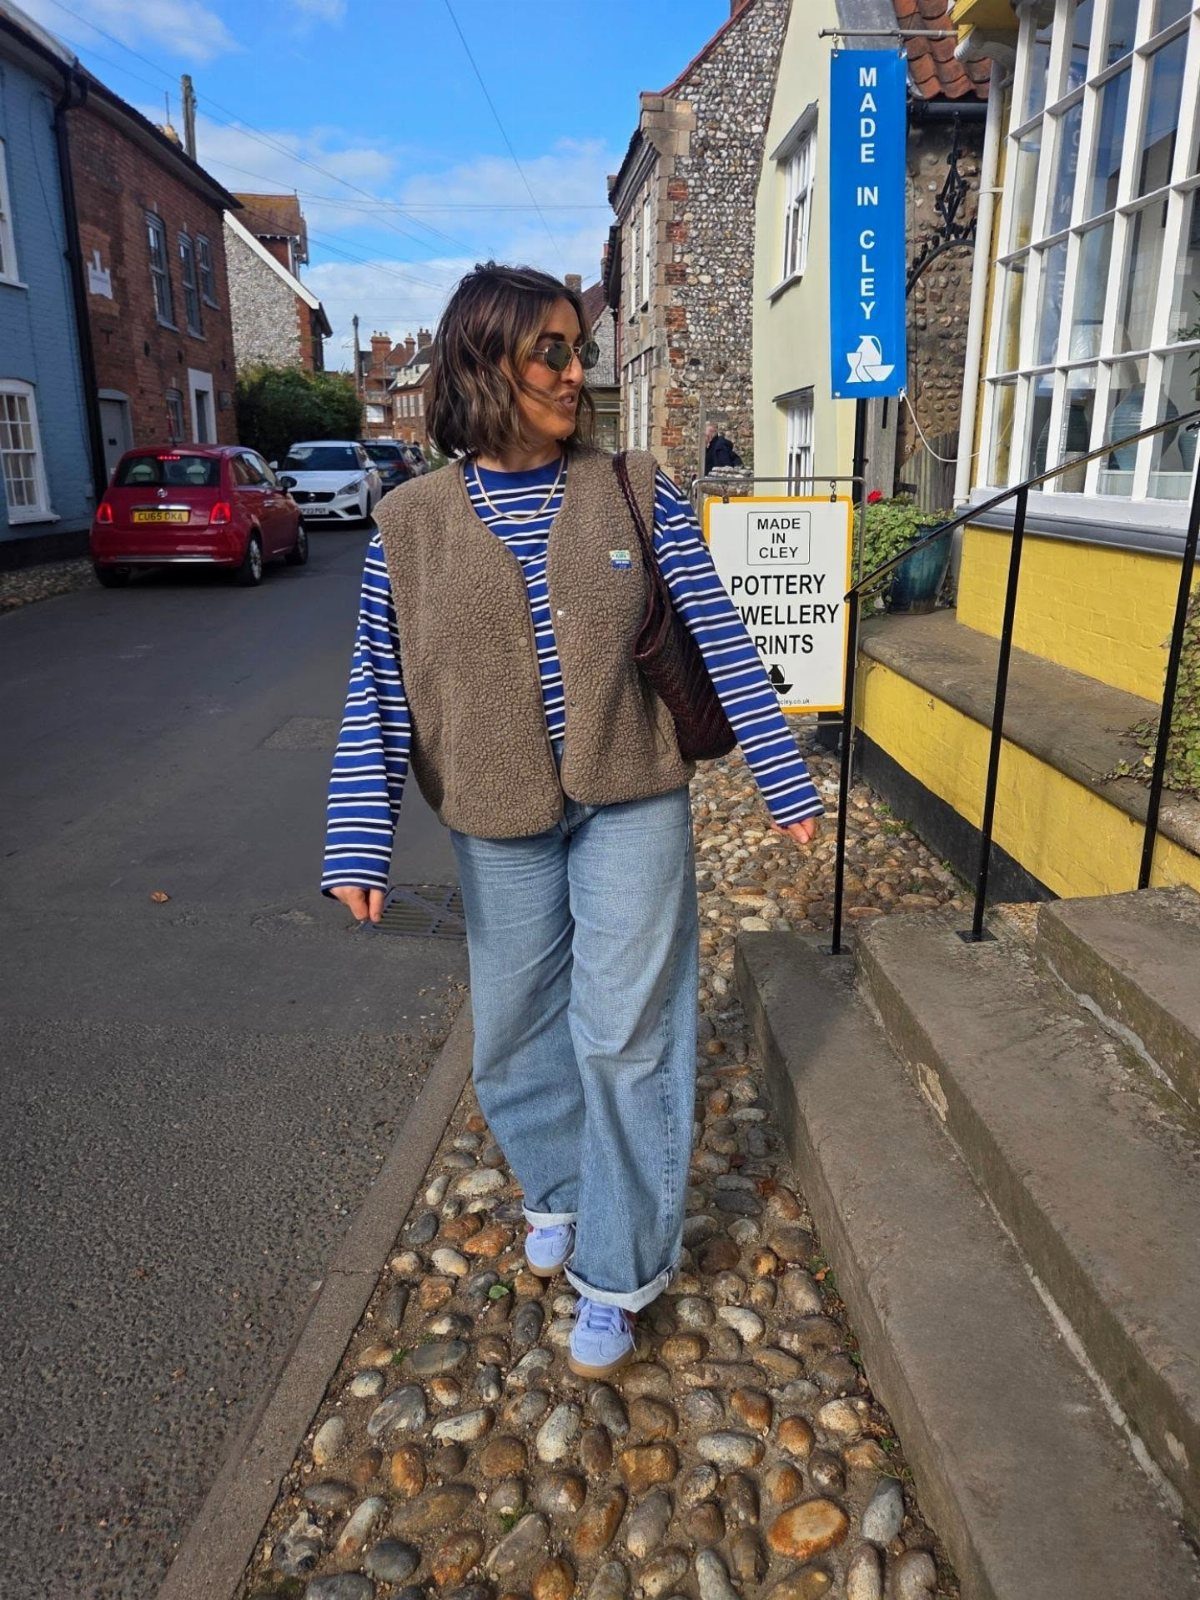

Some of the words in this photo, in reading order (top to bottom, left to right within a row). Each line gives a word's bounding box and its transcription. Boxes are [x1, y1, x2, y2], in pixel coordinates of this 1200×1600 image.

[859, 67, 877, 163] MADE
[857, 186, 879, 205] IN
[858, 230, 877, 320] CLEY
[138, 512, 162, 521] CU65
[757, 518, 801, 529] MADE
[771, 533, 786, 544] IN
[759, 547, 800, 559] CLEY
[731, 574, 826, 596] POTTERY
[735, 604, 839, 625] WELLERY
[755, 634, 814, 655] RINTS
[780, 697, 810, 706] cley.co.uk
